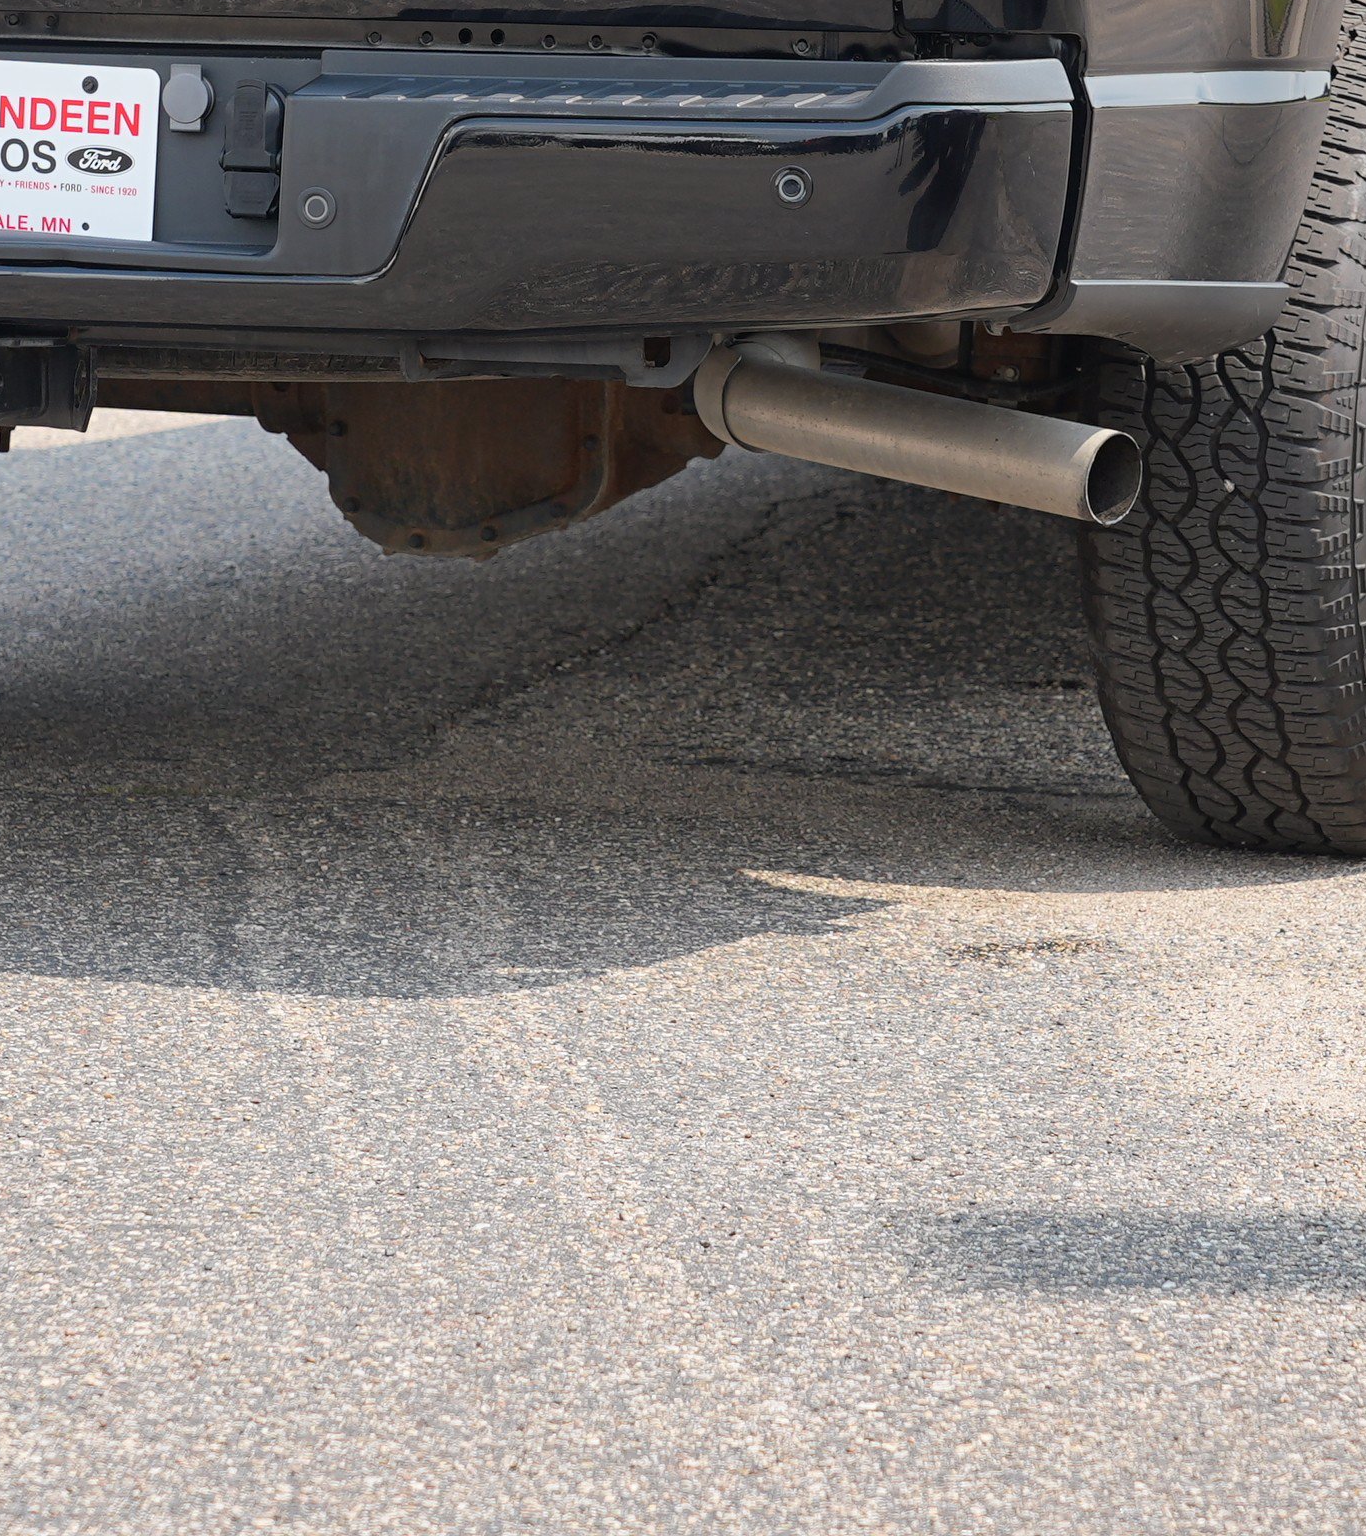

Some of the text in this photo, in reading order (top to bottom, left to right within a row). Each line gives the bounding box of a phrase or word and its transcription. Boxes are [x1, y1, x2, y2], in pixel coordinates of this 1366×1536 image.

[79, 148, 122, 172] Ford
[15, 180, 50, 191] FRIENDS
[60, 183, 82, 193] FORD
[90, 185, 115, 195] SINCE
[118, 187, 138, 197] 1920
[41, 216, 72, 233] MN
